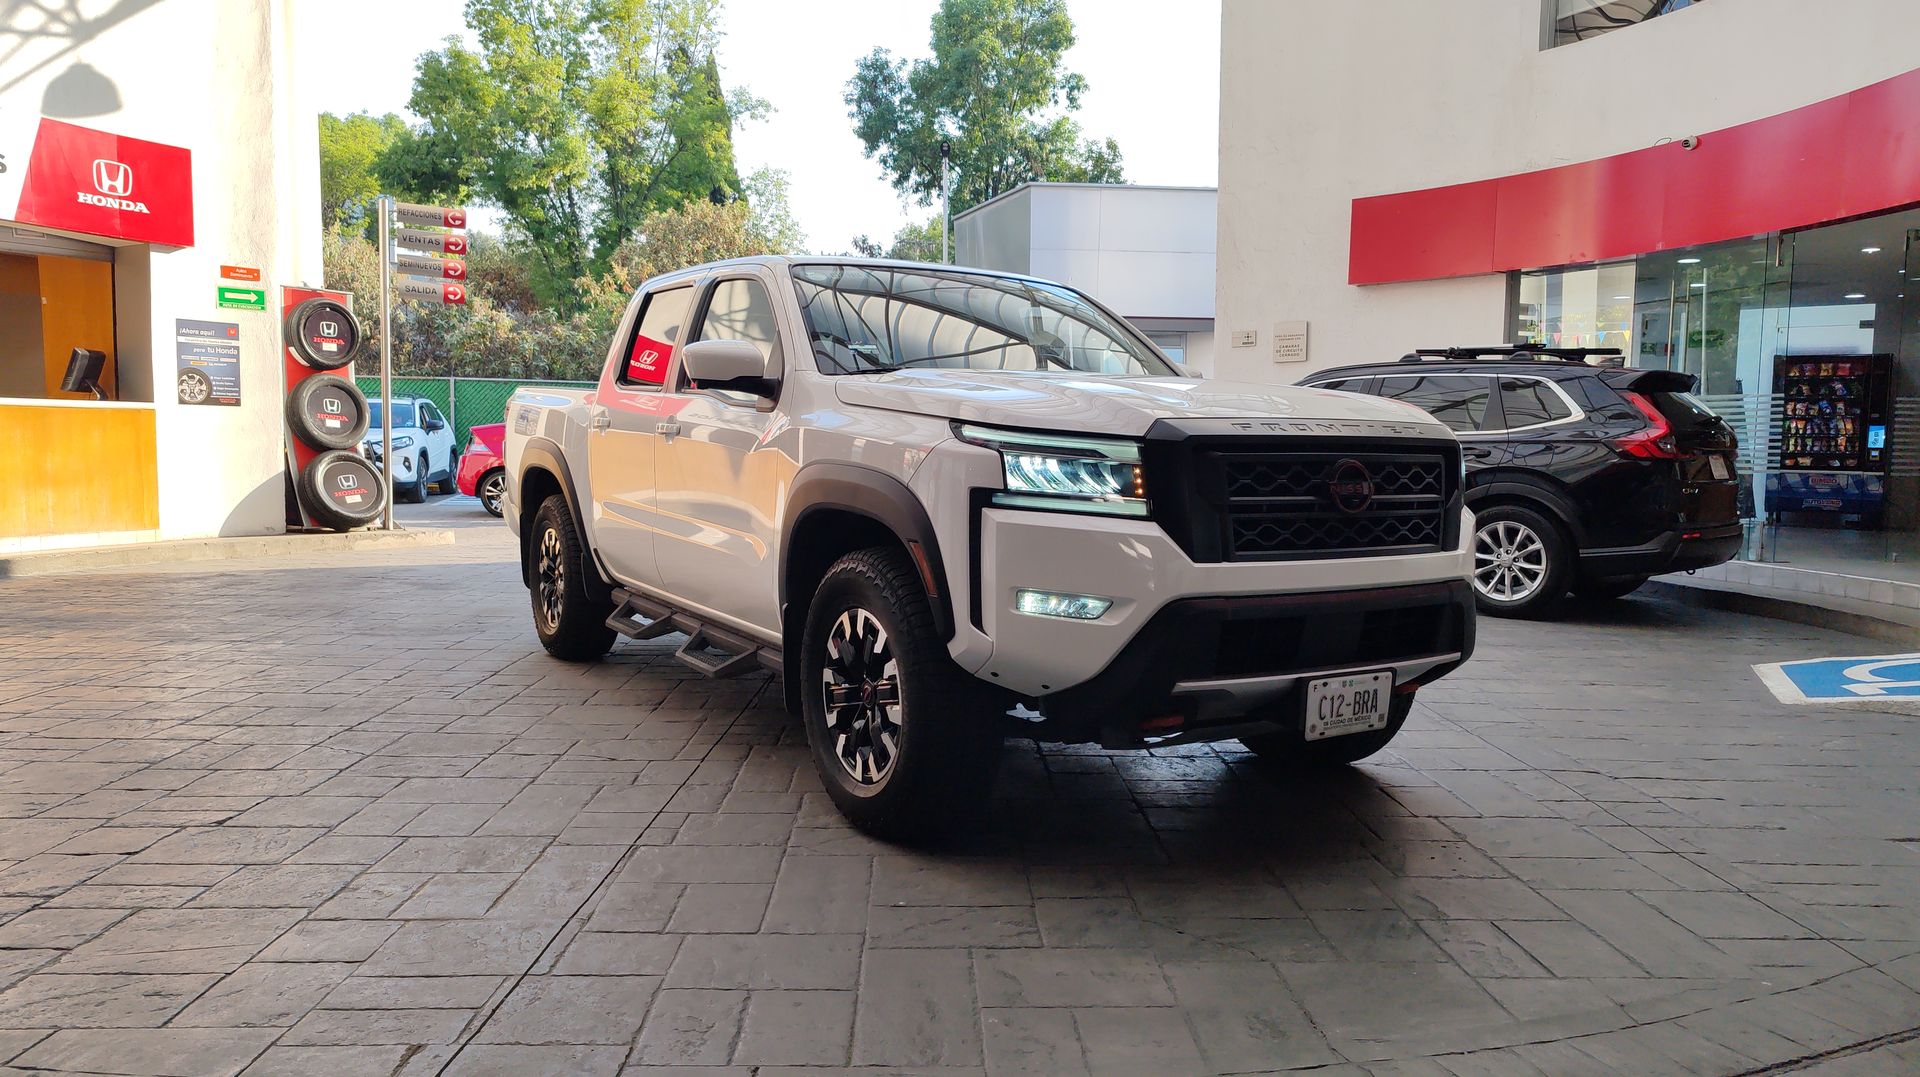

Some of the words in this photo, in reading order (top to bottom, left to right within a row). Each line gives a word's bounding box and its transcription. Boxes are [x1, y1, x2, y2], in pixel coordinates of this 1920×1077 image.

[77, 191, 150, 214] HONDA
[398, 208, 442, 220] REFACCIONES
[402, 235, 441, 246] VENTAS
[399, 261, 442, 271] SEMINUEVOS
[405, 285, 437, 295] SALIDA
[313, 337, 345, 345] HONDA
[316, 413, 349, 422] HONDA
[1231, 422, 1425, 435] FRONTIER
[334, 488, 368, 497] HONDA
[1318, 688, 1379, 720] C12-BRA
